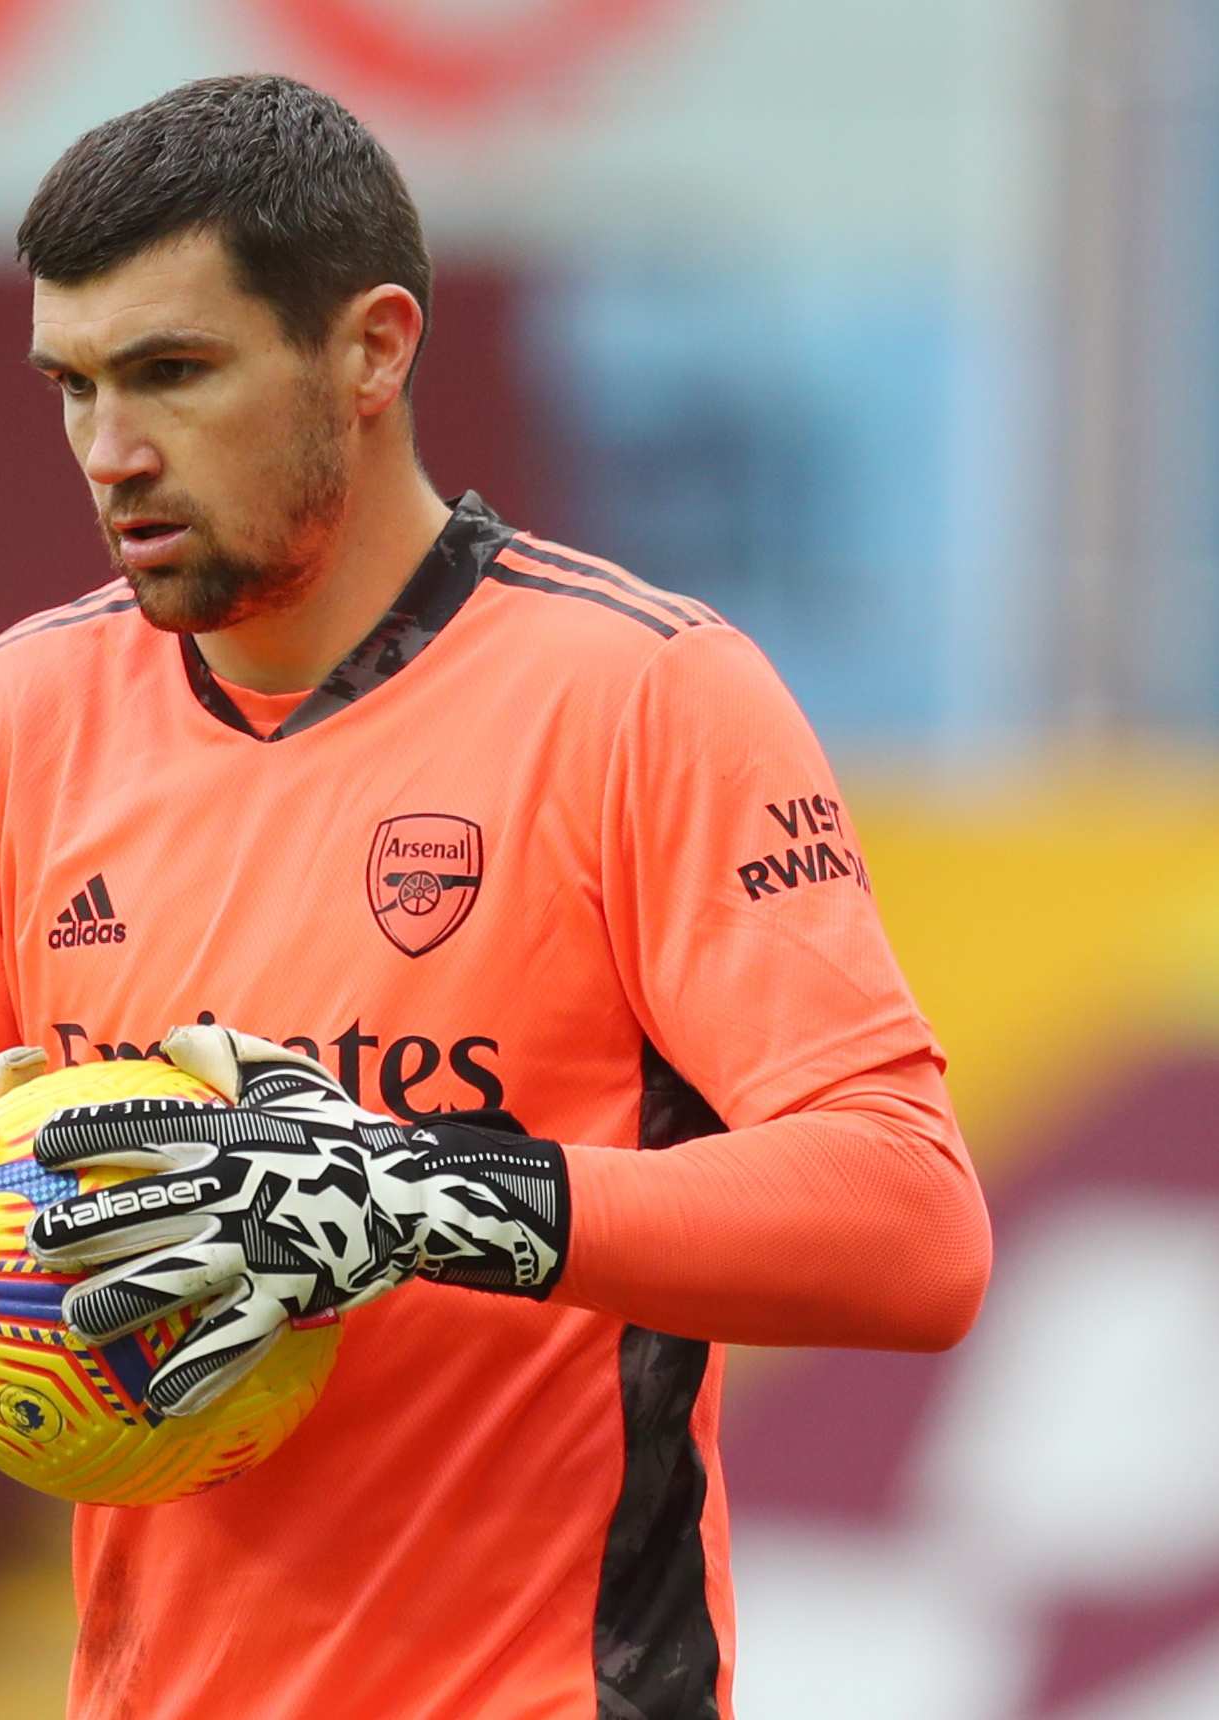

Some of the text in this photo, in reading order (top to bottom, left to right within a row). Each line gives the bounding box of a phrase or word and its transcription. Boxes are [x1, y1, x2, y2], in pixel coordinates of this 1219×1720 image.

[385, 837, 466, 860] Arsenal
[48, 918, 126, 950] adidas
[44, 1177, 221, 1236] Kaliaaer
